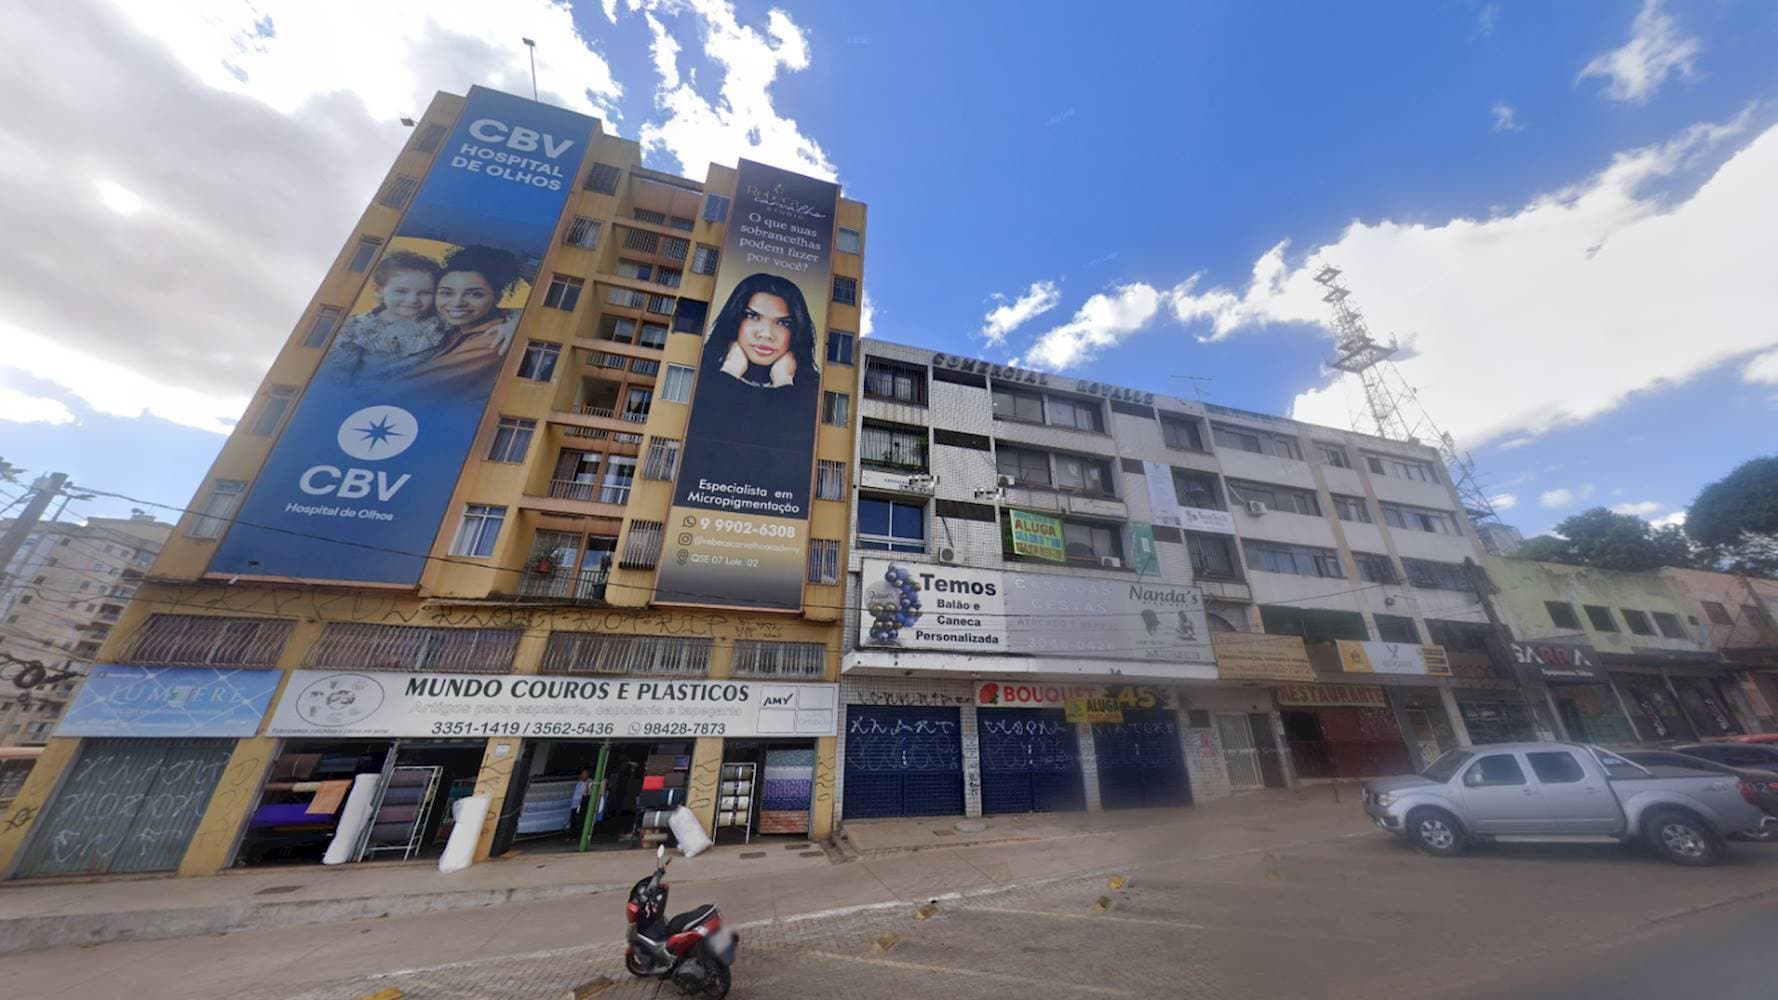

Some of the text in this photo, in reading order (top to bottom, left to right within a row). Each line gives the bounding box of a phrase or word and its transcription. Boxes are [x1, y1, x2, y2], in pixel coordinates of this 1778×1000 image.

[468, 119, 575, 159] CBV
[460, 143, 564, 178] HOSPITAL
[451, 156, 562, 191] DE OLHOS
[748, 212, 817, 237] O que suas
[740, 224, 822, 250] sobrancelhas
[739, 237, 819, 263] podem fazer
[746, 252, 808, 273] por você?
[932, 351, 1049, 386] COMERCIAL
[299, 464, 412, 502] CBV
[698, 478, 793, 500] Especialista em
[285, 502, 394, 521] Hospital de Olhos
[687, 491, 800, 514] Micropigmentação
[700, 517, 796, 539] 9 9902-6308
[1015, 519, 1056, 537] ALUGA
[747, 558, 760, 568] 02
[920, 573, 997, 596] Temos
[1129, 584, 1199, 605] Nanda's
[937, 598, 971, 610] Balão
[937, 615, 982, 627] Caneca
[916, 630, 999, 644] Personalizada
[405, 678, 502, 698] MUNDO
[511, 680, 610, 700] COUROS
[617, 683, 631, 700] E
[1279, 685, 1385, 704] RESTAURANTE
[408, 701, 471, 716] Artigos
[763, 693, 793, 707] AMY
[1087, 699, 1120, 712] ALUGA
[432, 721, 726, 735] 3351-1419 / 3562-5436 98428-7873
